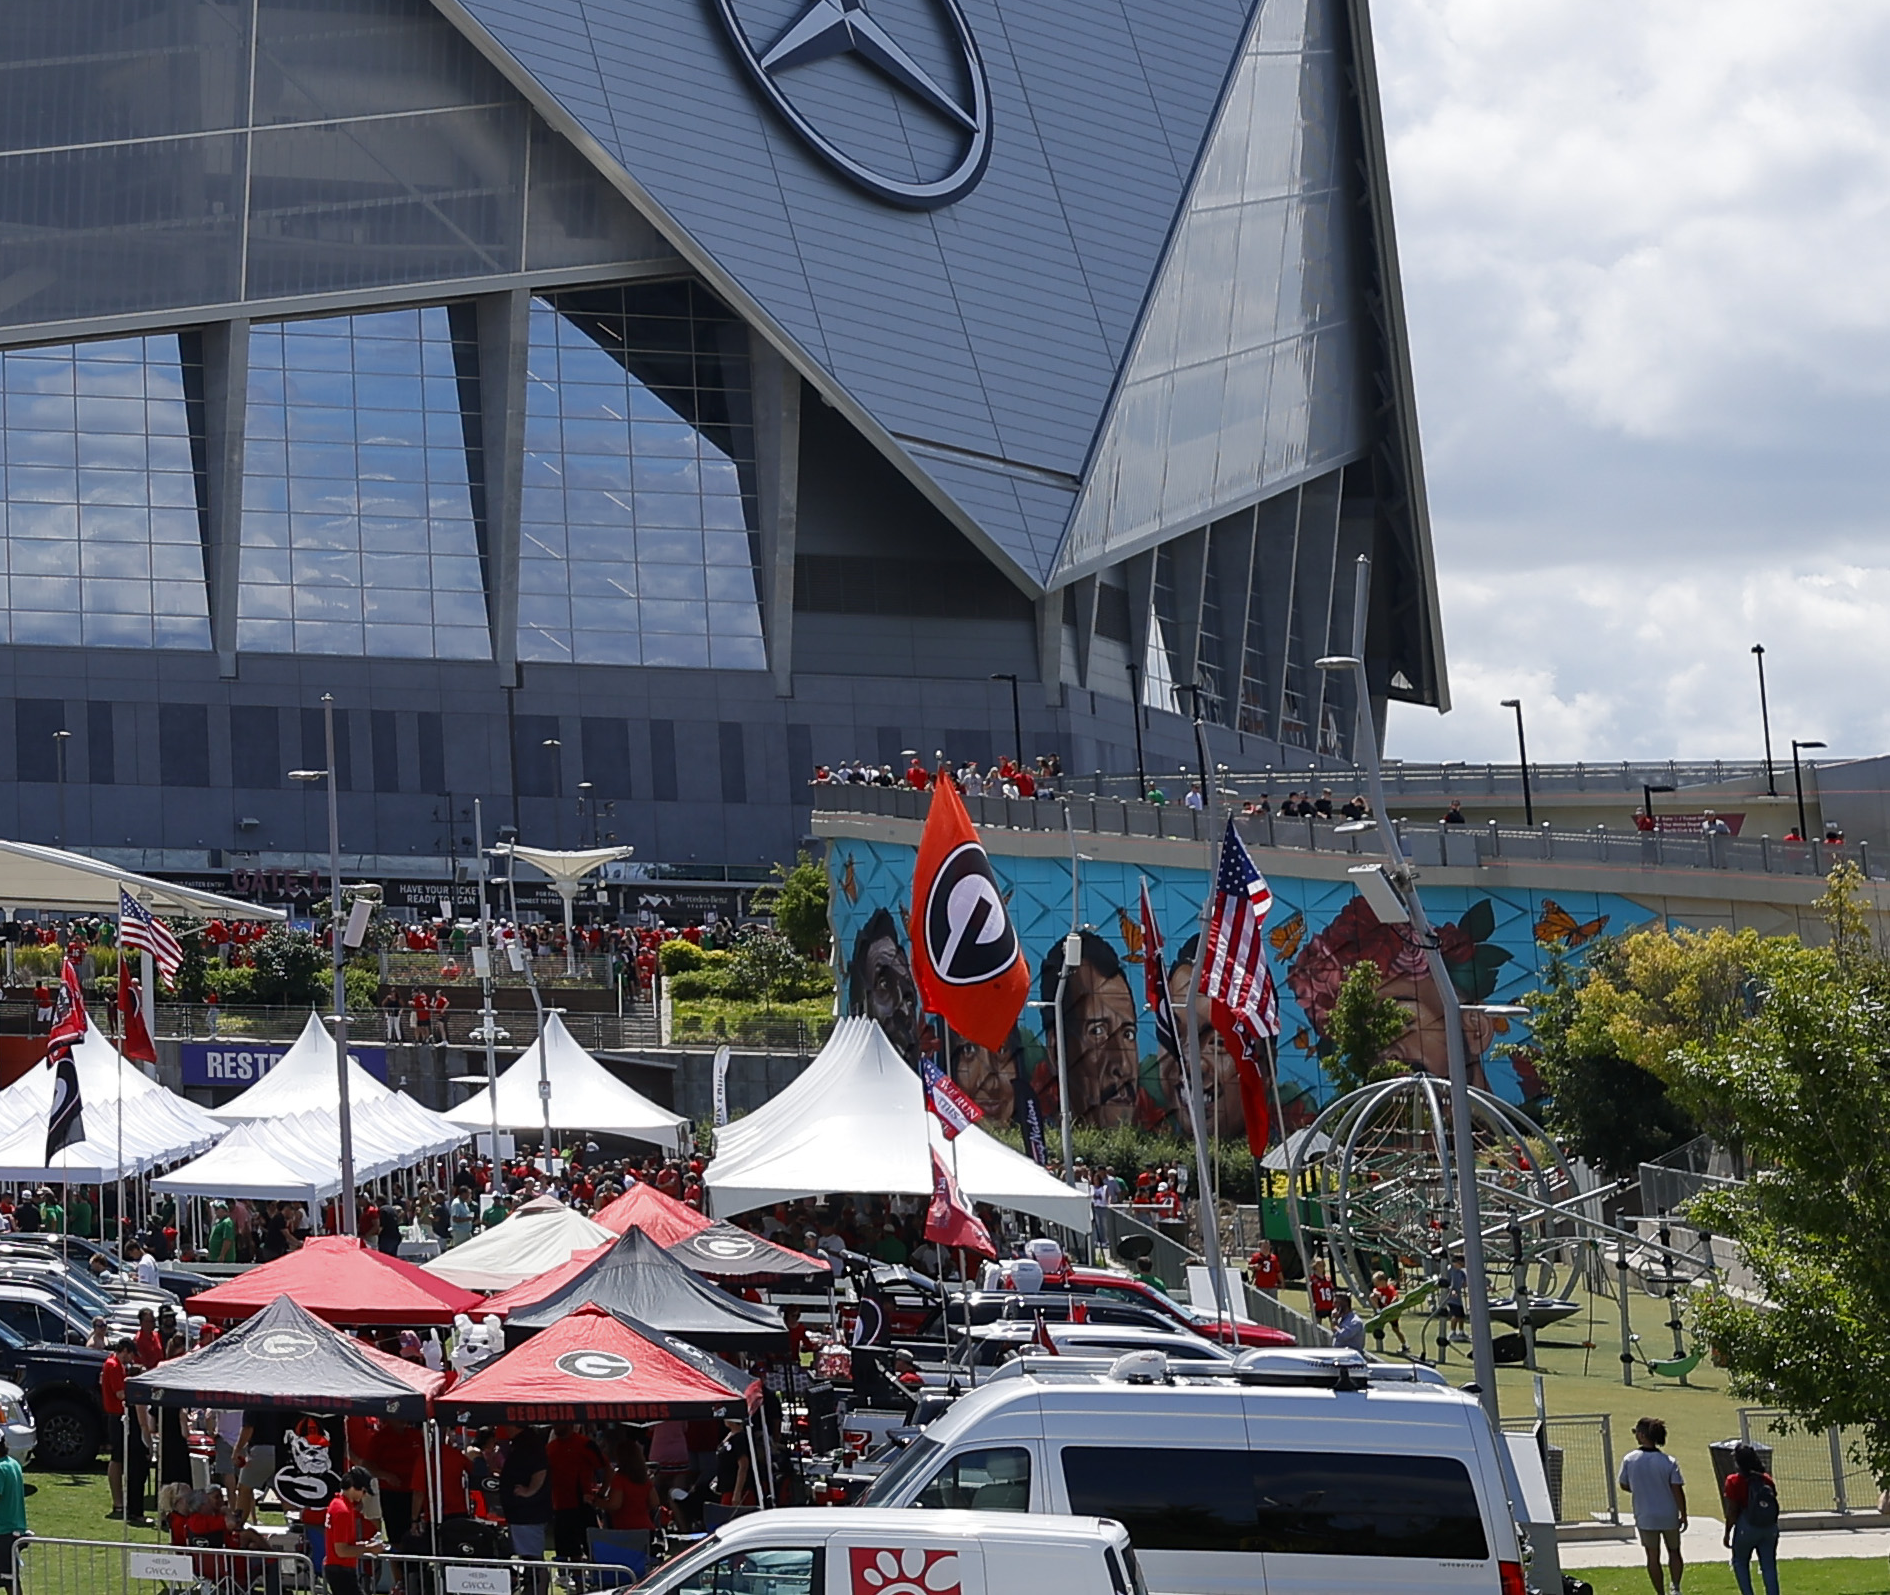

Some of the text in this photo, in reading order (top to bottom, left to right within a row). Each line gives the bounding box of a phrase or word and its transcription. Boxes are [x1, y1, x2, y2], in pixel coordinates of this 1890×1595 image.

[232, 868, 300, 894] GATE
[399, 884, 423, 894] HAVE
[425, 885, 449, 895] YOUR
[406, 894, 435, 904] READY
[676, 894, 728, 904] Mercedes-Benz
[1262, 1260, 1271, 1273] 3
[506, 1404, 670, 1422] GEORGIA BULLDOGS
[145, 1566, 178, 1577] GWCCA
